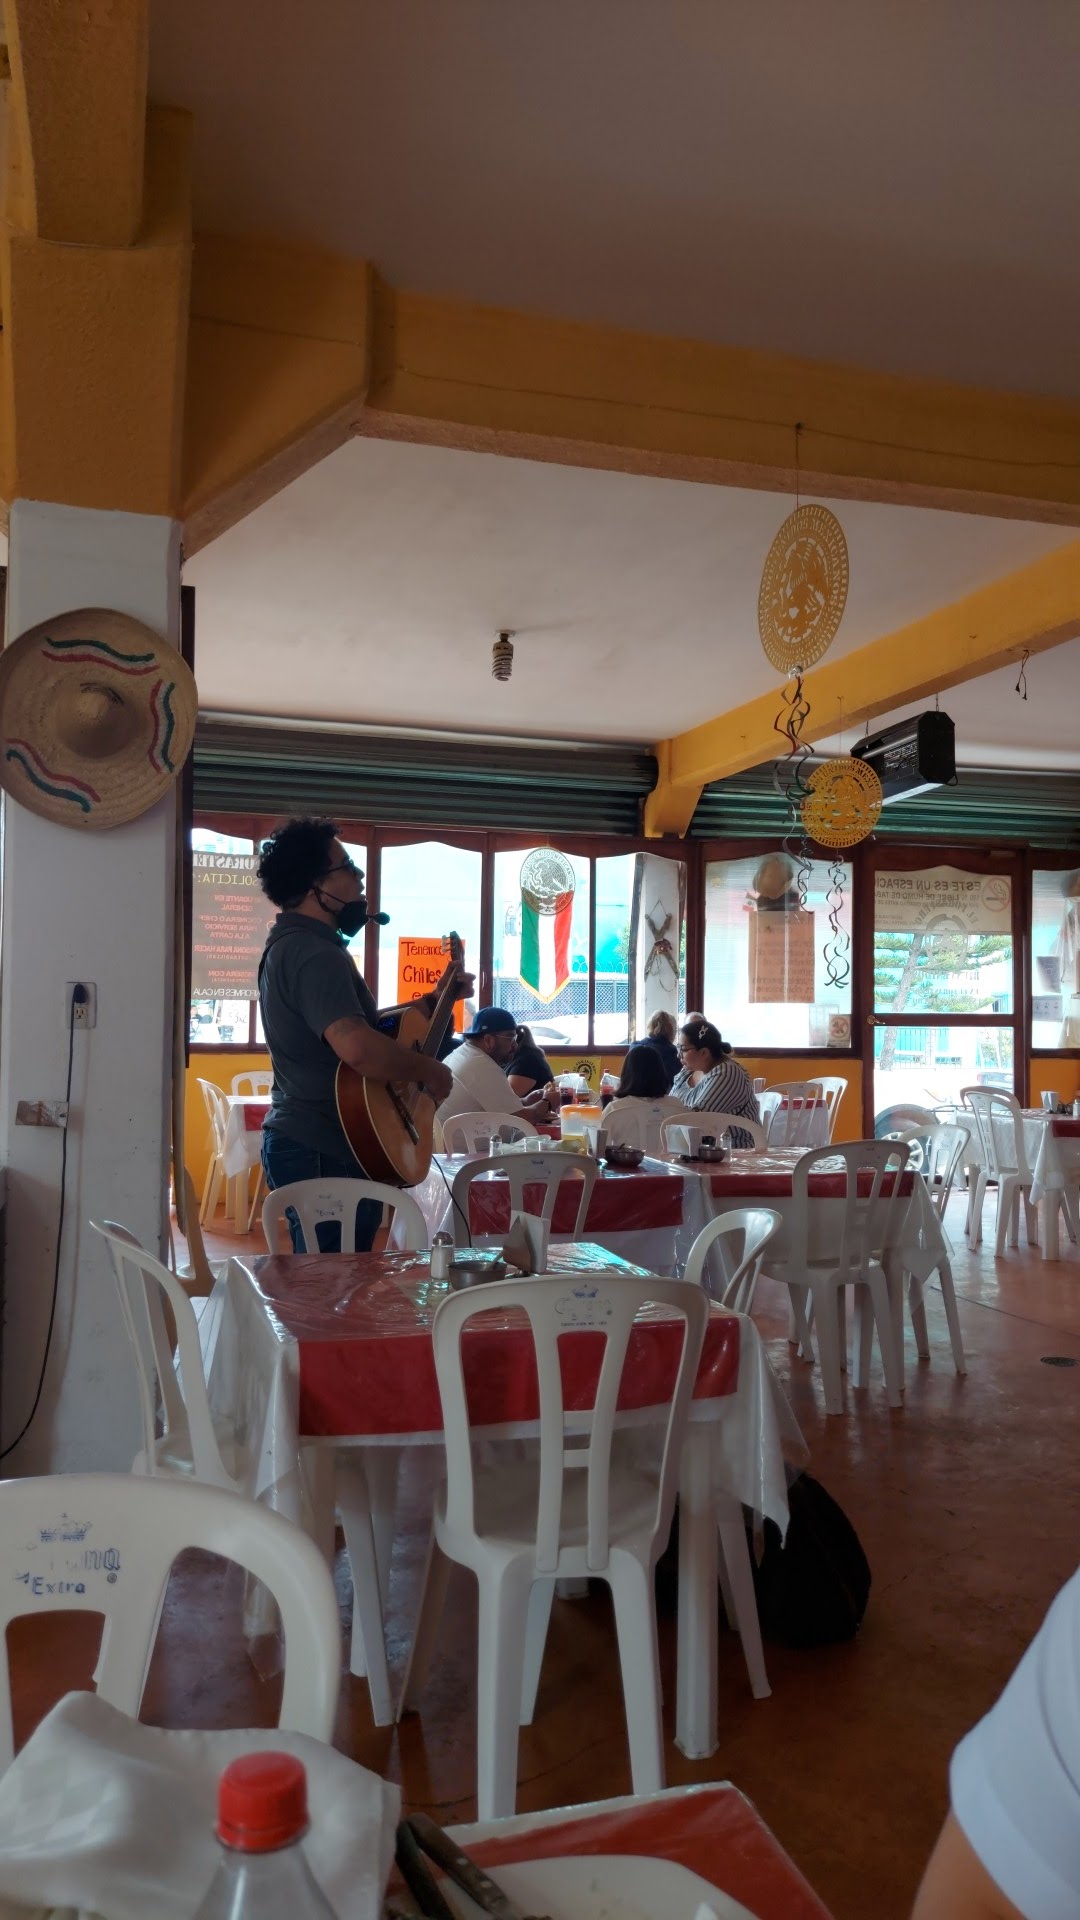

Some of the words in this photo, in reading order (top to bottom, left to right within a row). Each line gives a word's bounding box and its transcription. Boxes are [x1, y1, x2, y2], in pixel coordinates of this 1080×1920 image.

[401, 942, 446, 956] Tenemo
[402, 965, 442, 984] Chiles
[32, 1576, 86, 1595] Extra
